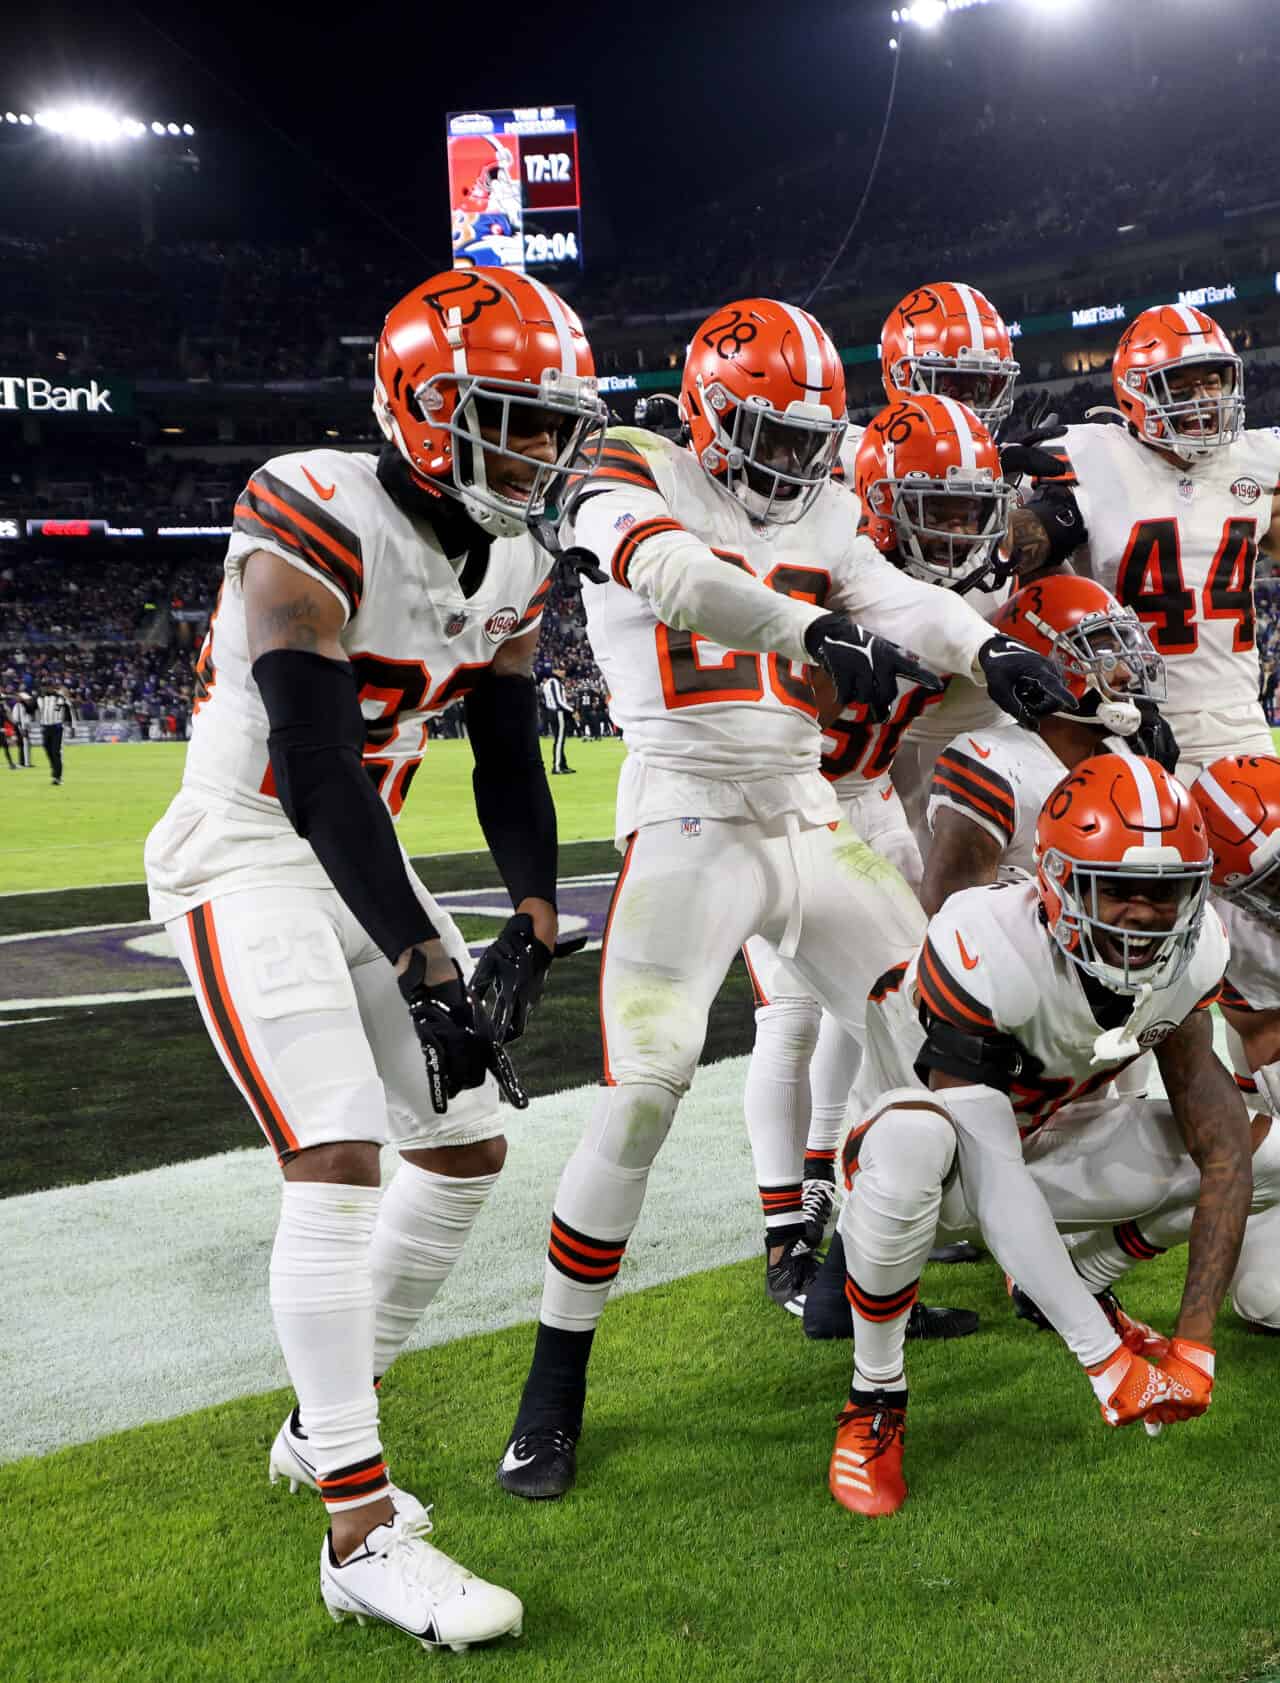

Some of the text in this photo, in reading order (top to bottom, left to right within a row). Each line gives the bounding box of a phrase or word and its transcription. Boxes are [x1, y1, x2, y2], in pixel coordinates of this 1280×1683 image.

[524, 153, 570, 182] 17:12
[524, 232, 578, 262] 29:04
[703, 311, 757, 360] 28
[27, 377, 113, 412] Bank
[1116, 516, 1258, 655] 44
